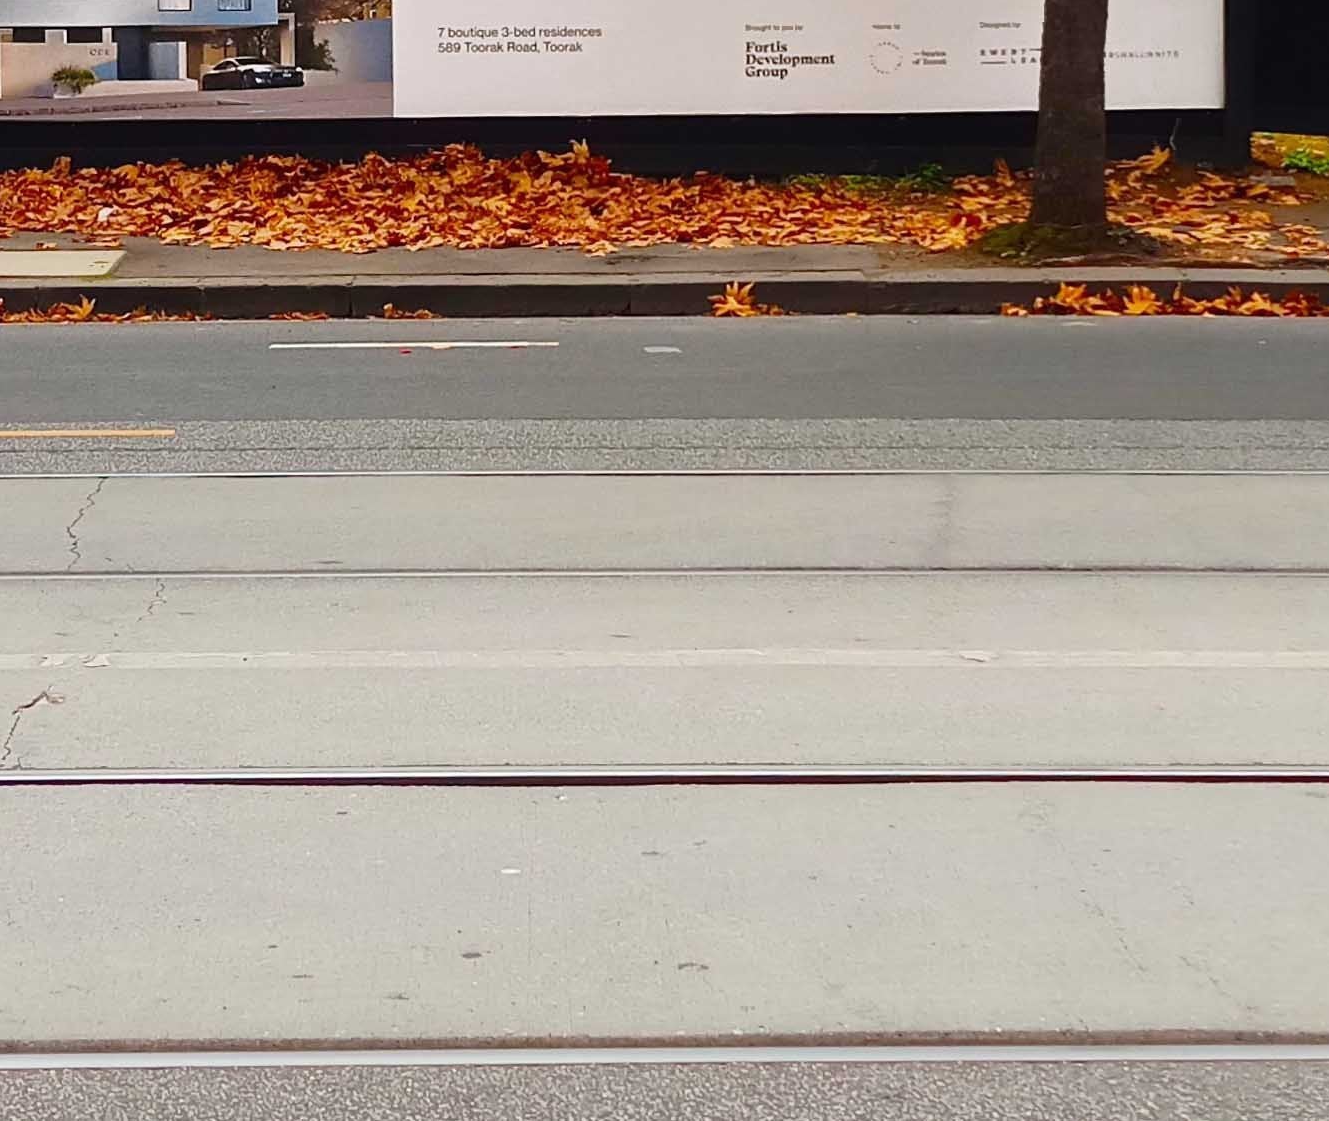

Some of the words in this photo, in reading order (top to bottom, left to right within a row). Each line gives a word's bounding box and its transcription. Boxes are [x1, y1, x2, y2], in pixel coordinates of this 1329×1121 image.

[437, 27, 446, 38] 7
[447, 26, 499, 40] boutique
[501, 26, 536, 38] 3-bed
[538, 25, 603, 38] residences
[437, 41, 462, 54] 589
[463, 41, 504, 53] Toorak
[506, 41, 541, 54] Road,
[542, 40, 583, 53] Toorak
[745, 40, 788, 54] Fortis
[745, 53, 836, 69] Development
[745, 65, 789, 80] Group
